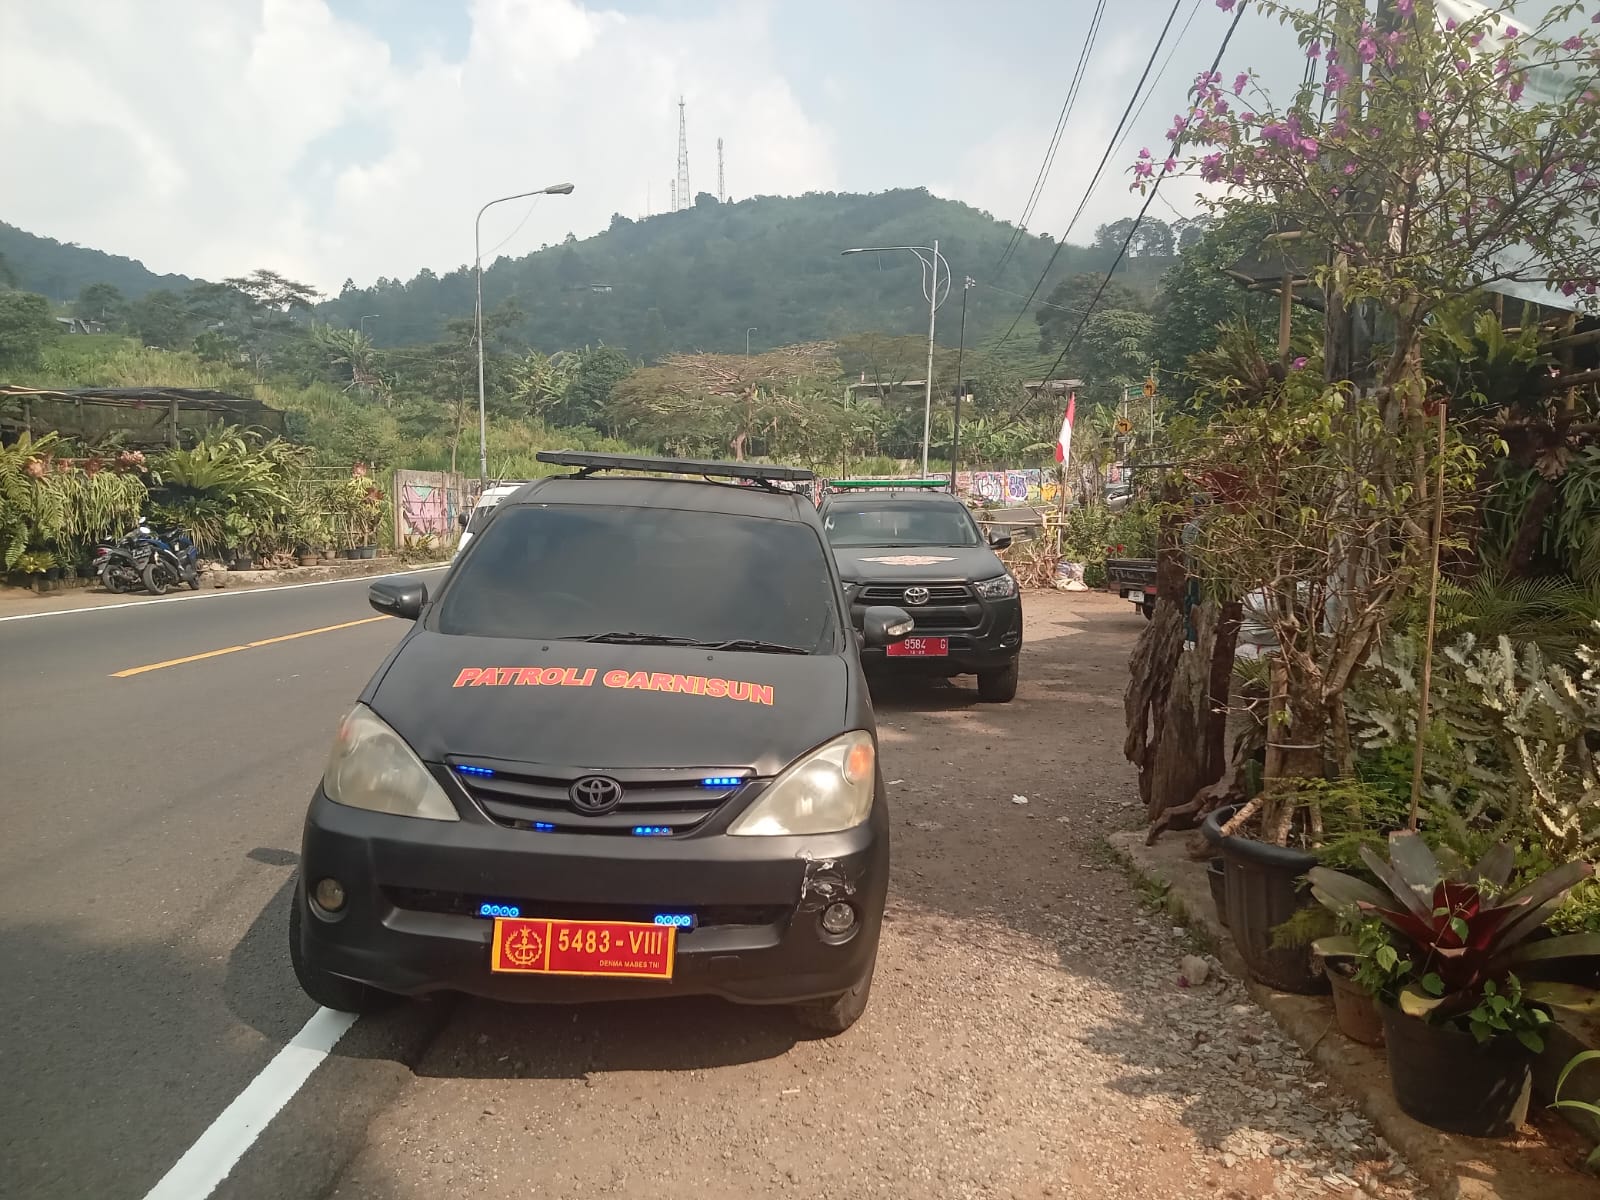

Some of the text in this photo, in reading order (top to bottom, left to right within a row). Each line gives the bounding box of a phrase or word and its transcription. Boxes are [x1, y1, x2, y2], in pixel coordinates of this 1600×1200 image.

[904, 639, 926, 649] 9584
[452, 667, 774, 706] PATROLI GARNISUN
[558, 929, 610, 953] 5483
[629, 930, 663, 955] VIII
[599, 959, 660, 969] DENMA MABES TNI
